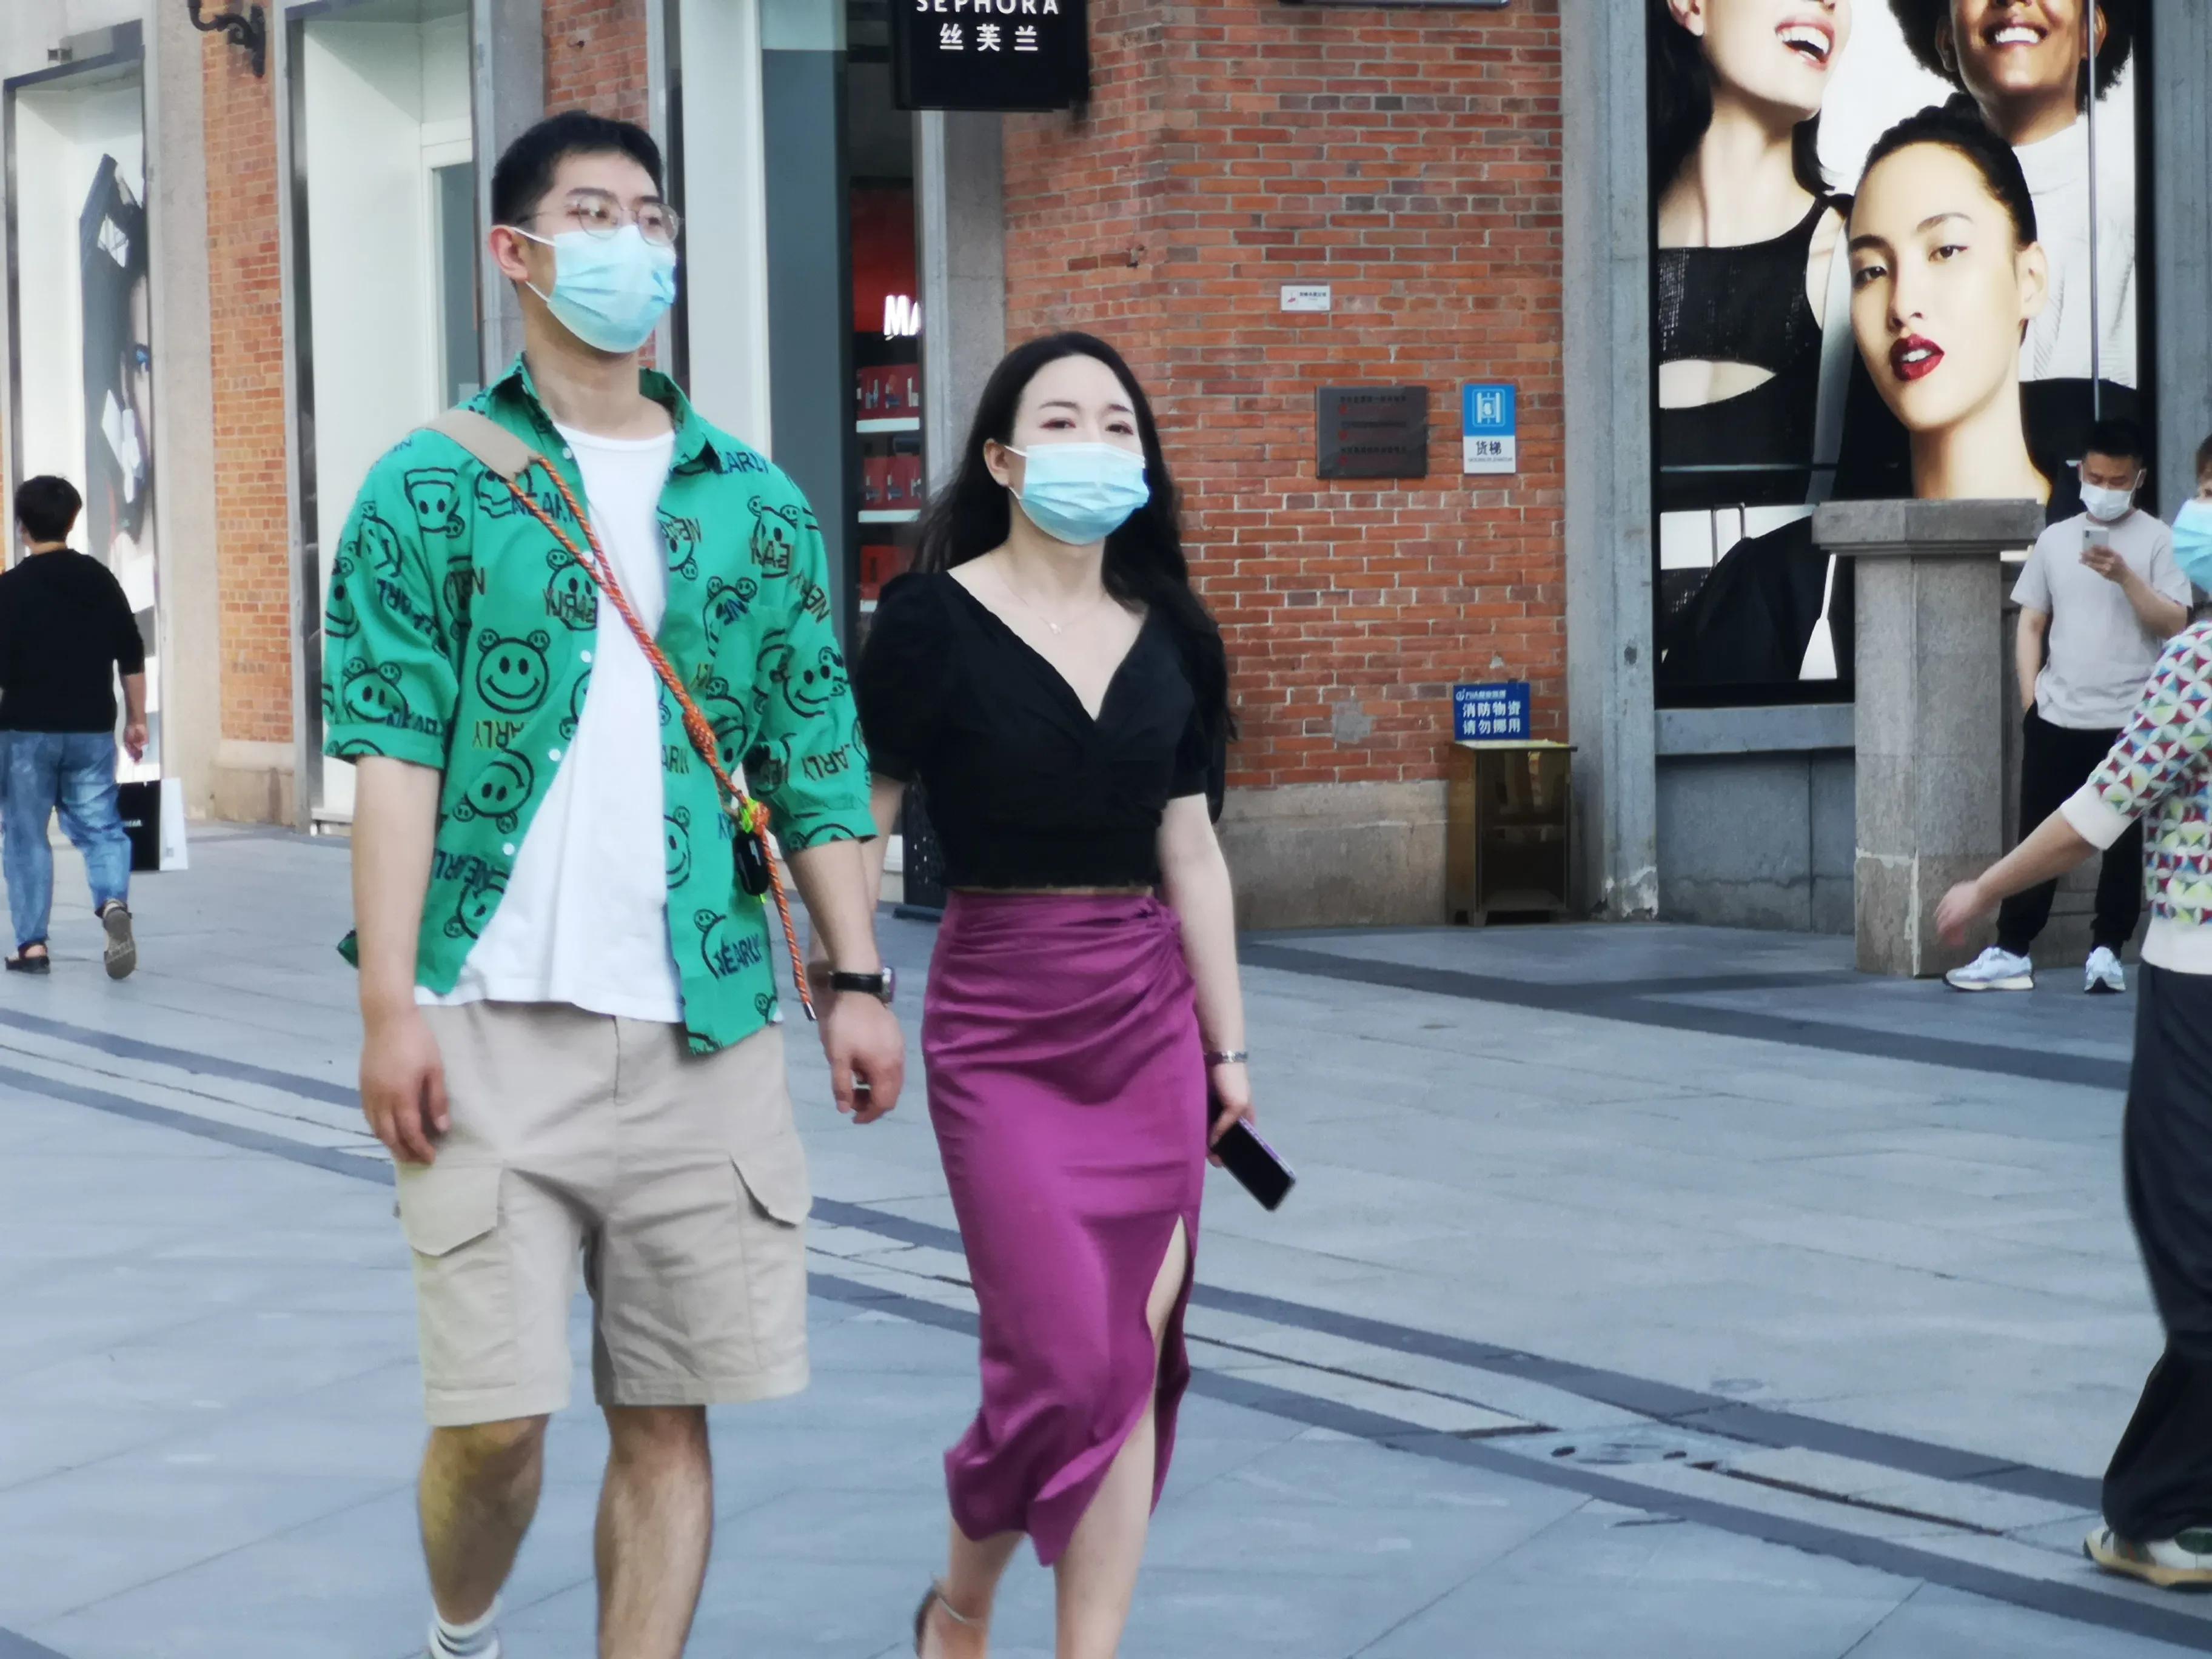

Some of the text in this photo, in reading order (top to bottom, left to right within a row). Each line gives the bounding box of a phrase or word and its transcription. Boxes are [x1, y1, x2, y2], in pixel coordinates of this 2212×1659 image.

[916, 0, 1059, 15] SEPHORA
[940, 23, 1039, 51] 丝芙兰
[1476, 441, 1502, 456] 货梯
[801, 743, 850, 782] ARLY
